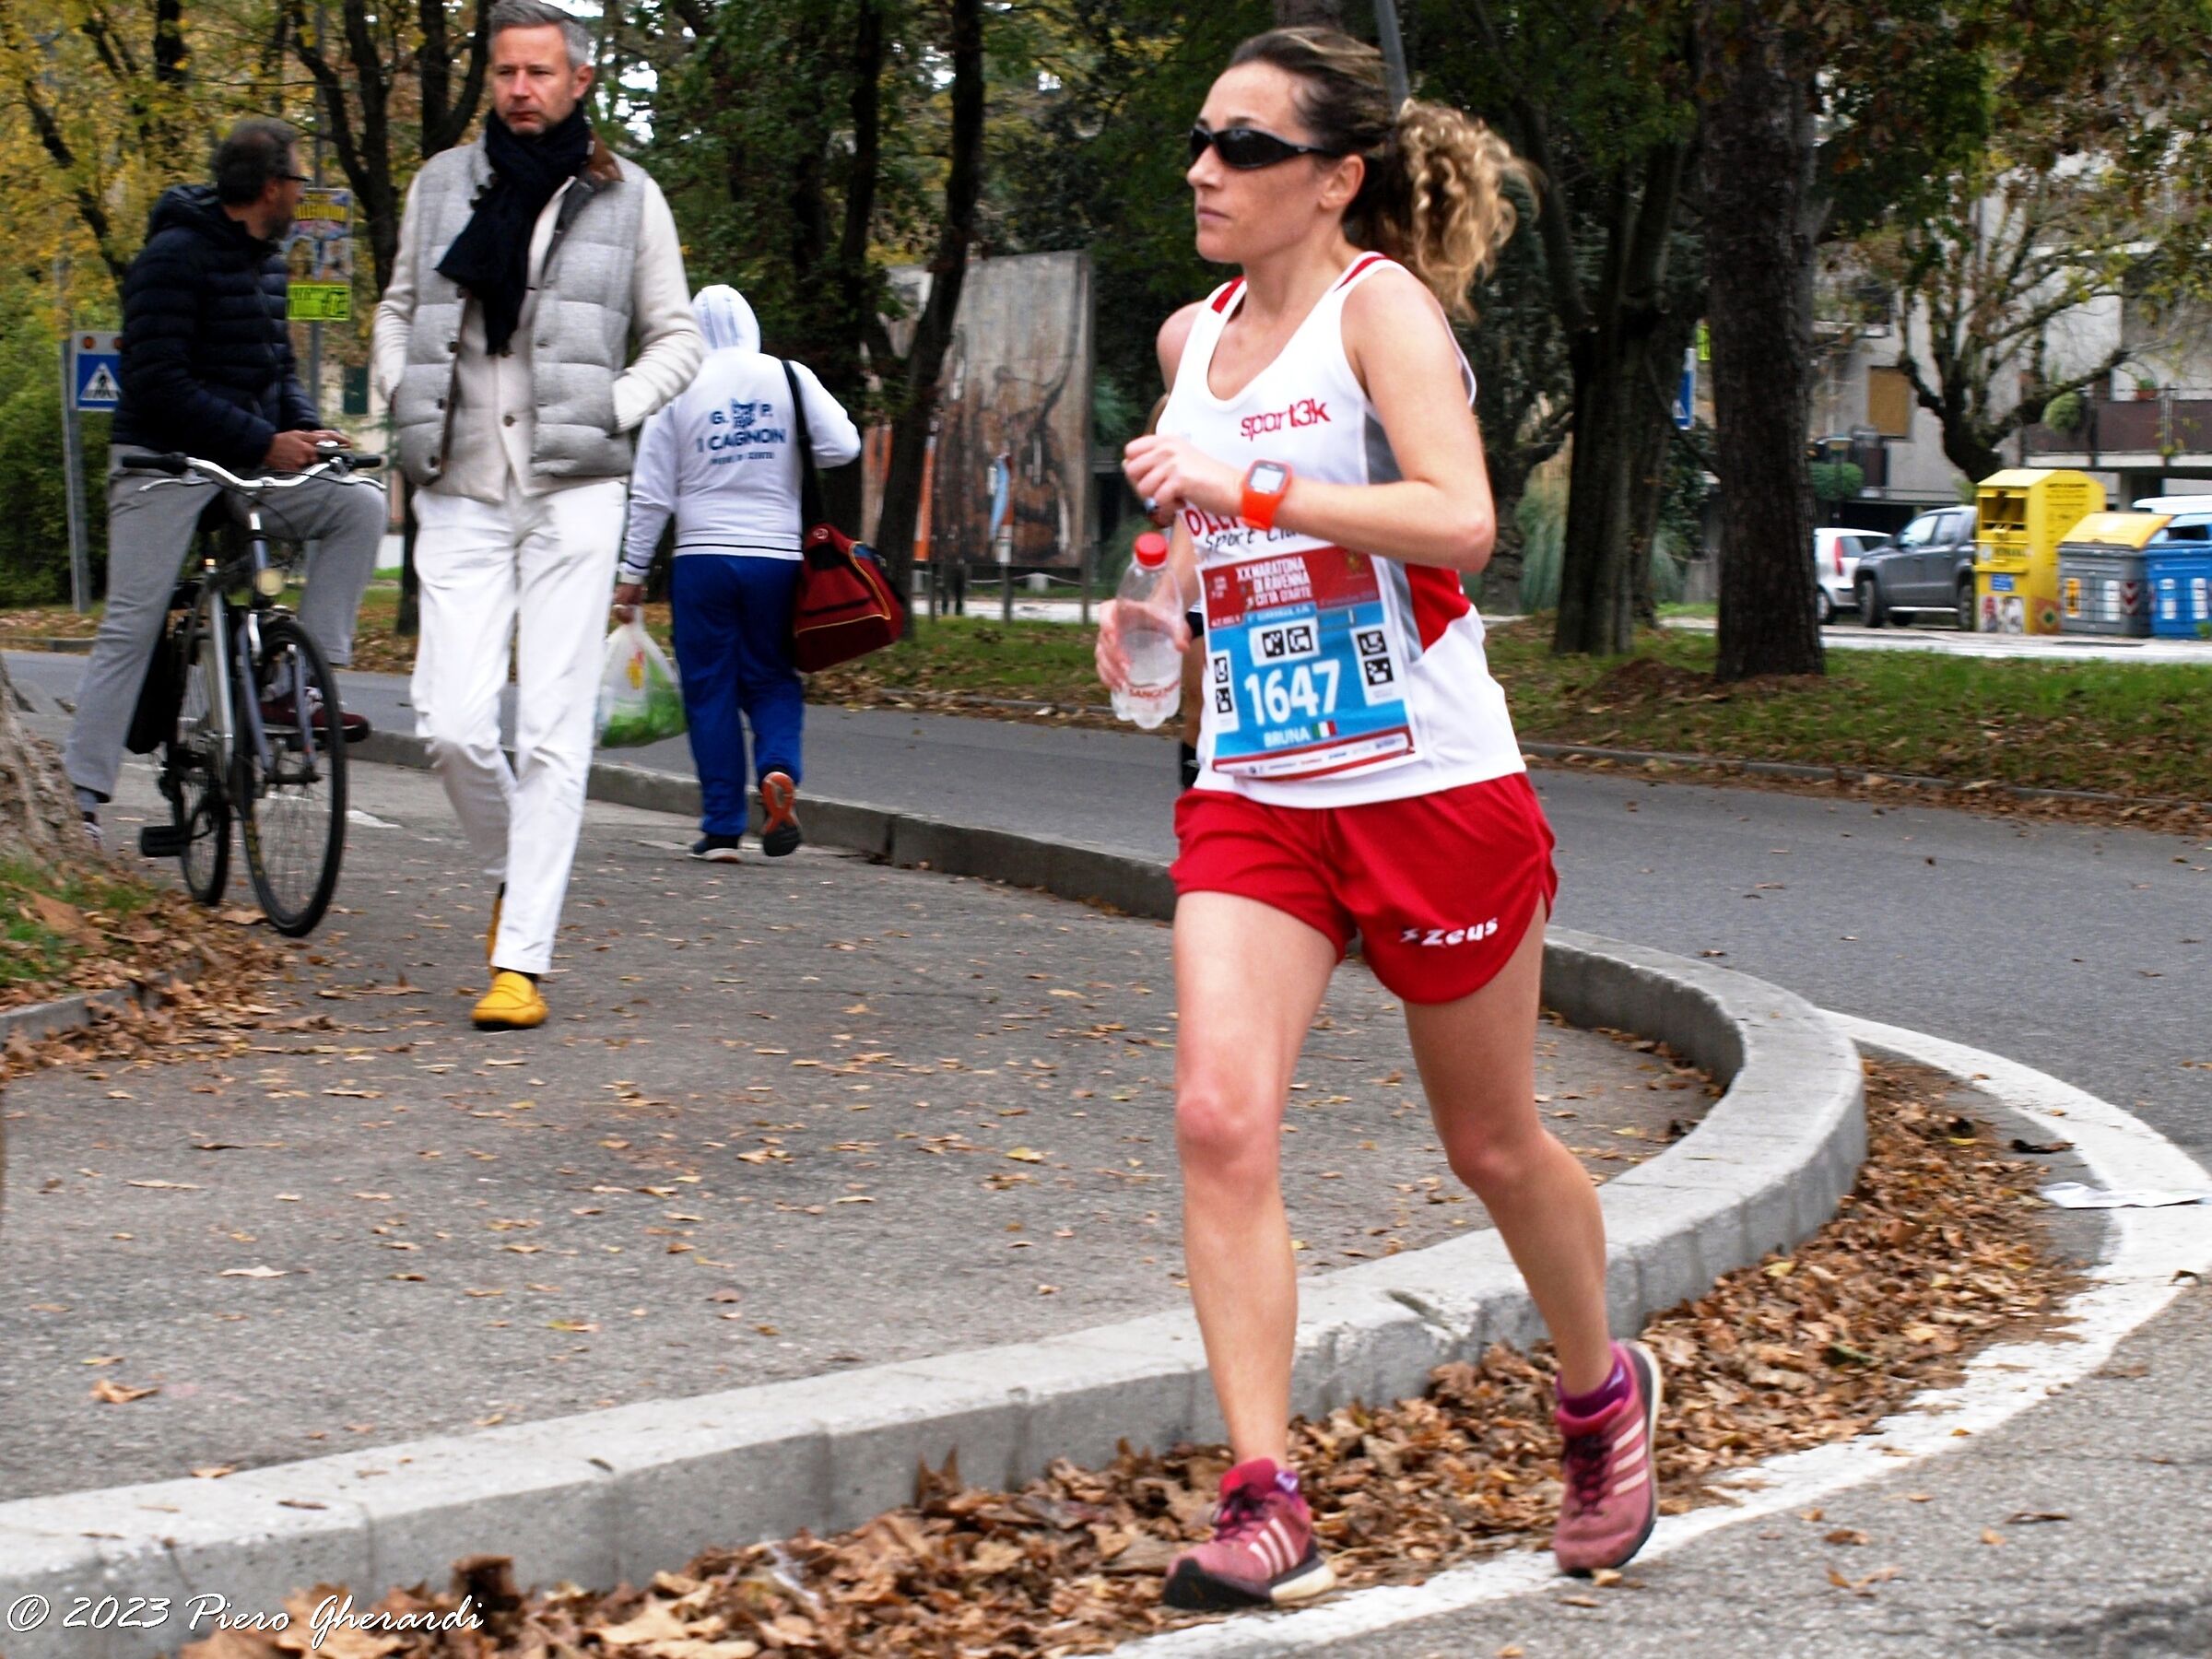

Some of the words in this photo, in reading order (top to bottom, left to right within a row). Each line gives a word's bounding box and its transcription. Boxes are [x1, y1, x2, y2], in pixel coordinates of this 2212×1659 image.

[1241, 398, 1331, 441] sport3k
[1244, 659, 1340, 726] 1647
[1264, 725, 1312, 748] BRUNA
